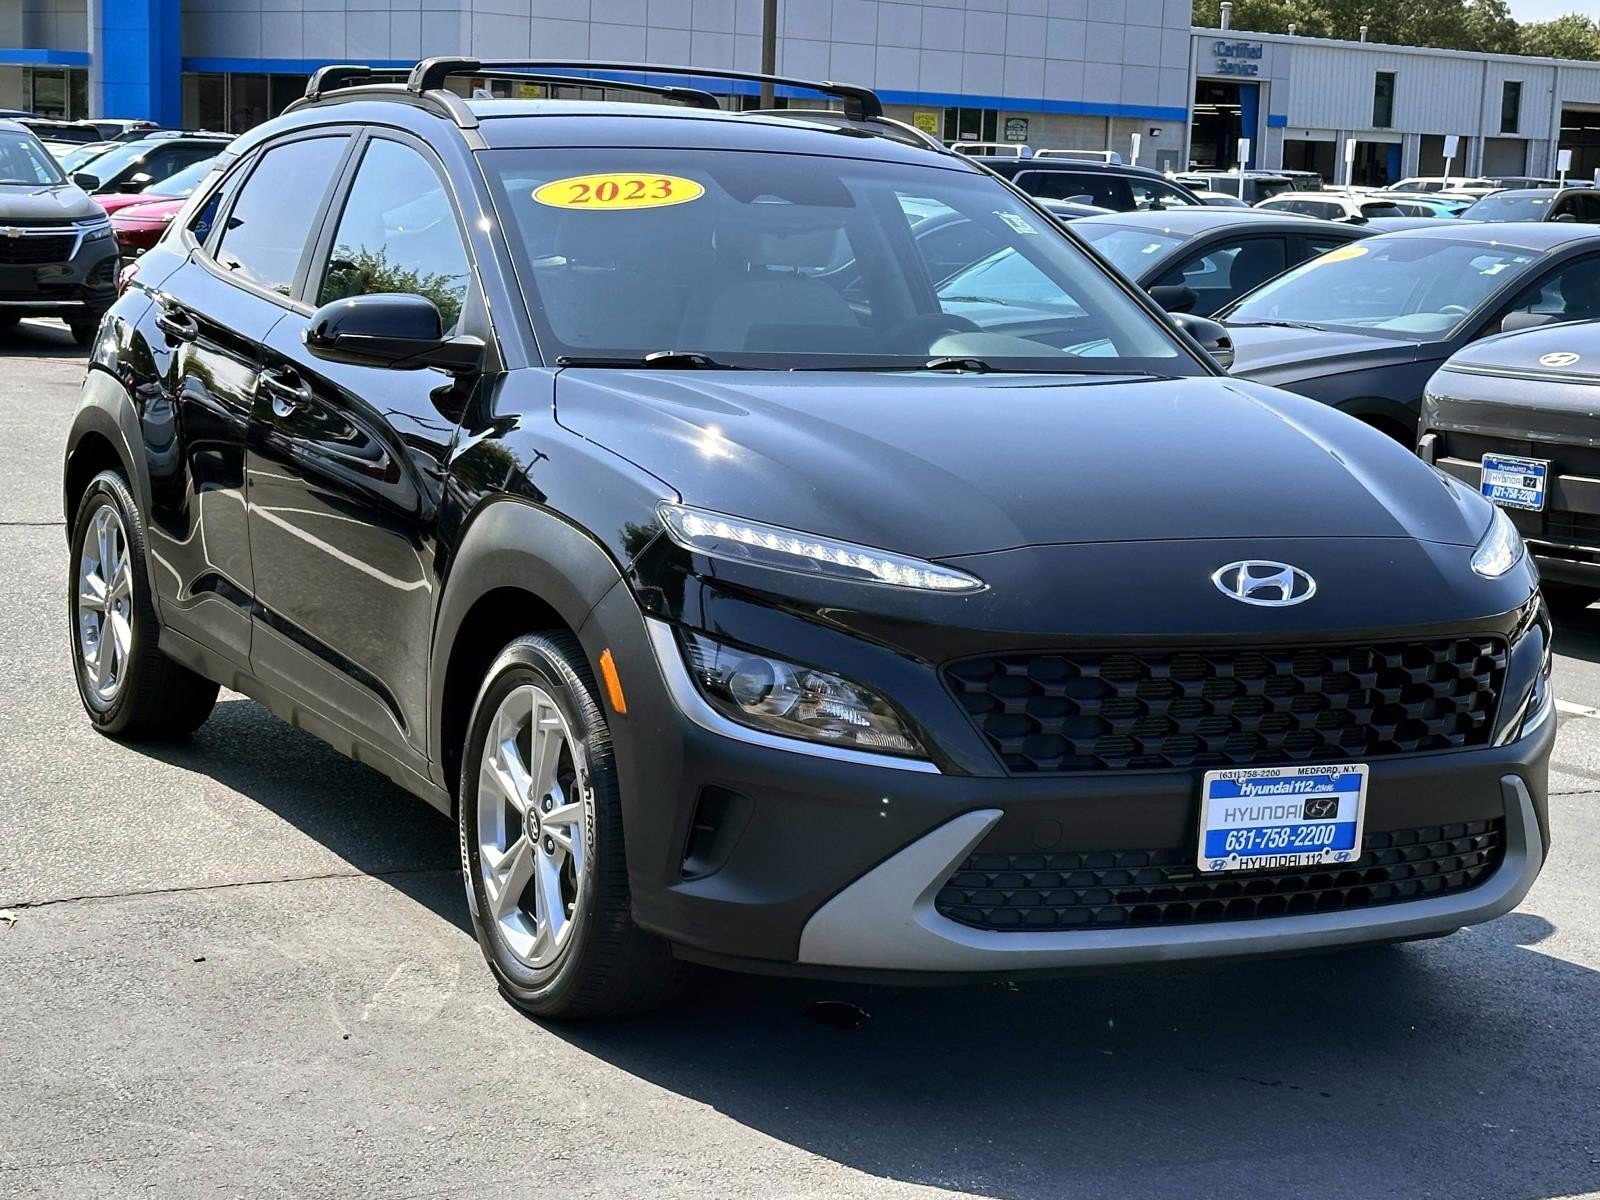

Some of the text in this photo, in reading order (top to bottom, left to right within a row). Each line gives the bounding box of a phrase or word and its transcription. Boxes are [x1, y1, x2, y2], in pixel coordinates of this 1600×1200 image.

[1213, 41, 1263, 59] Certified
[1215, 58, 1258, 76] Service
[568, 179, 673, 204] 2023
[1491, 473, 1522, 486] HYUNDAI
[1297, 766, 1341, 776] MEDFORD,
[1239, 780, 1335, 797] Hyundai112.com
[1224, 804, 1303, 823] HYUNDAI
[1225, 824, 1336, 851] 631-758-2200
[1239, 853, 1323, 870] HYUNDAI 112
